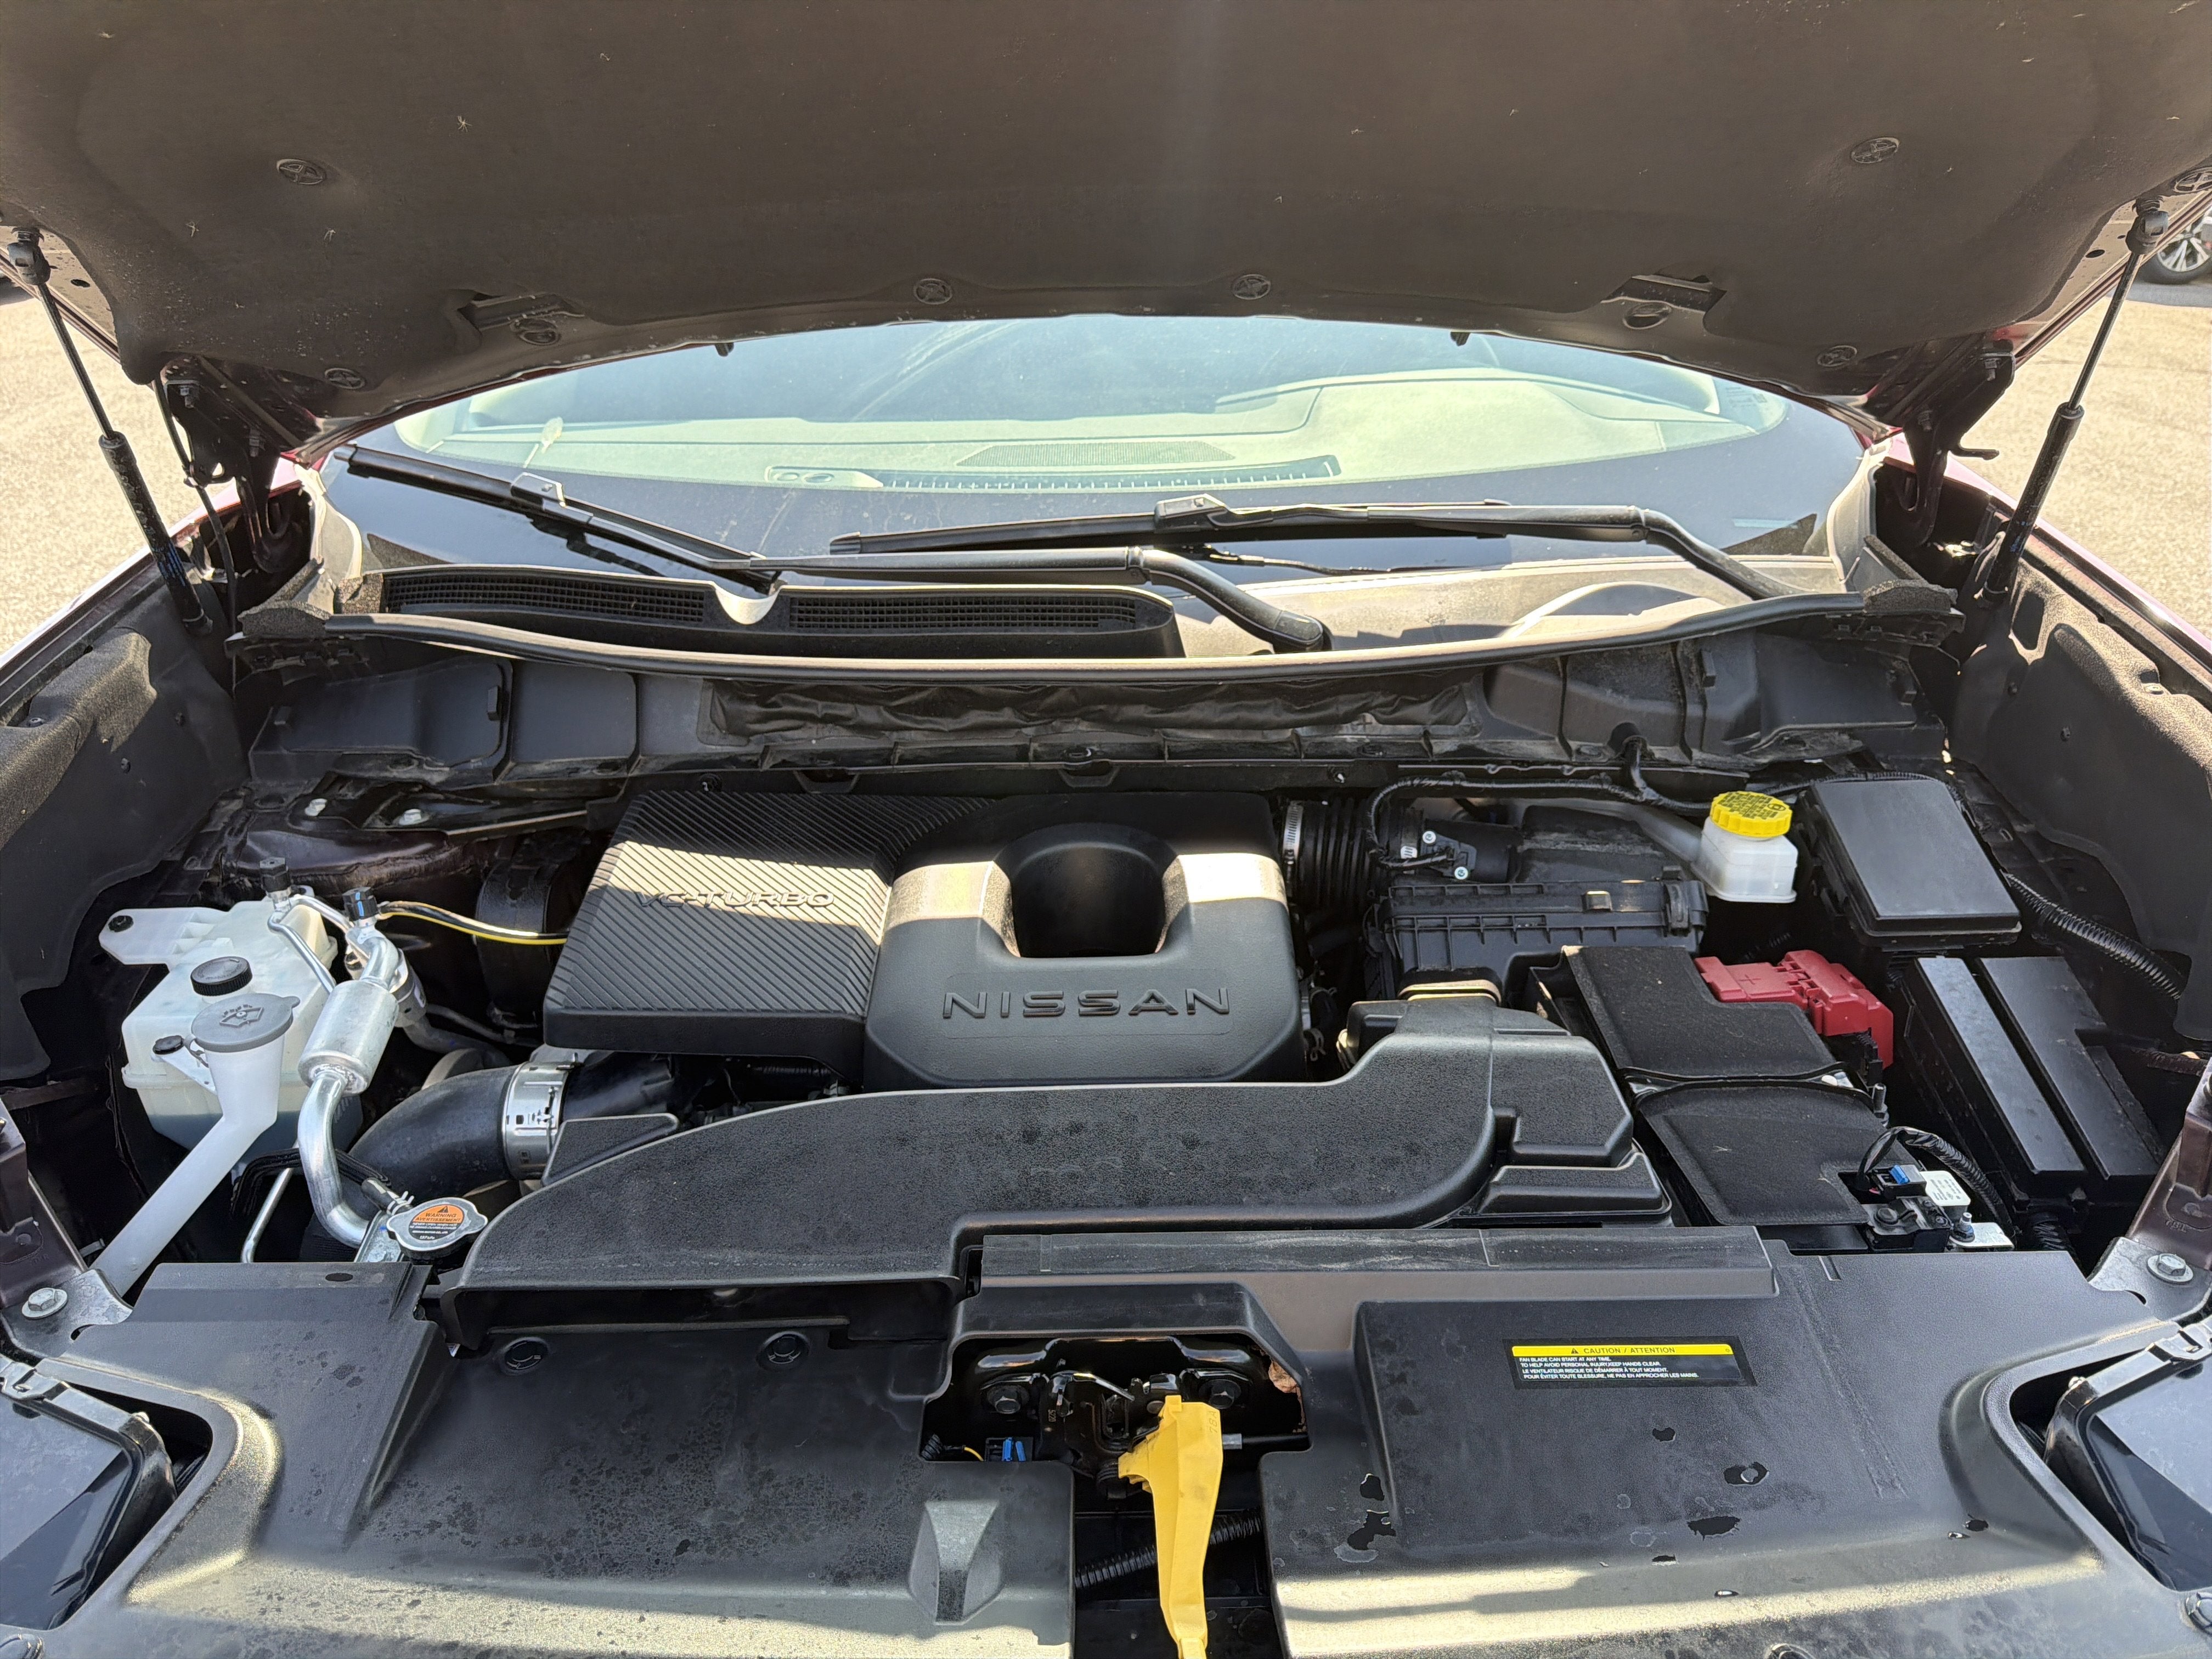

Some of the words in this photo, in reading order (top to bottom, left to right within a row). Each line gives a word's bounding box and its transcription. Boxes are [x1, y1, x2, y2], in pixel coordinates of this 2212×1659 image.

[635, 891, 835, 908] VC-TURBO
[942, 988, 1230, 1019] NISSAN
[1209, 1410, 1218, 1433] 78A
